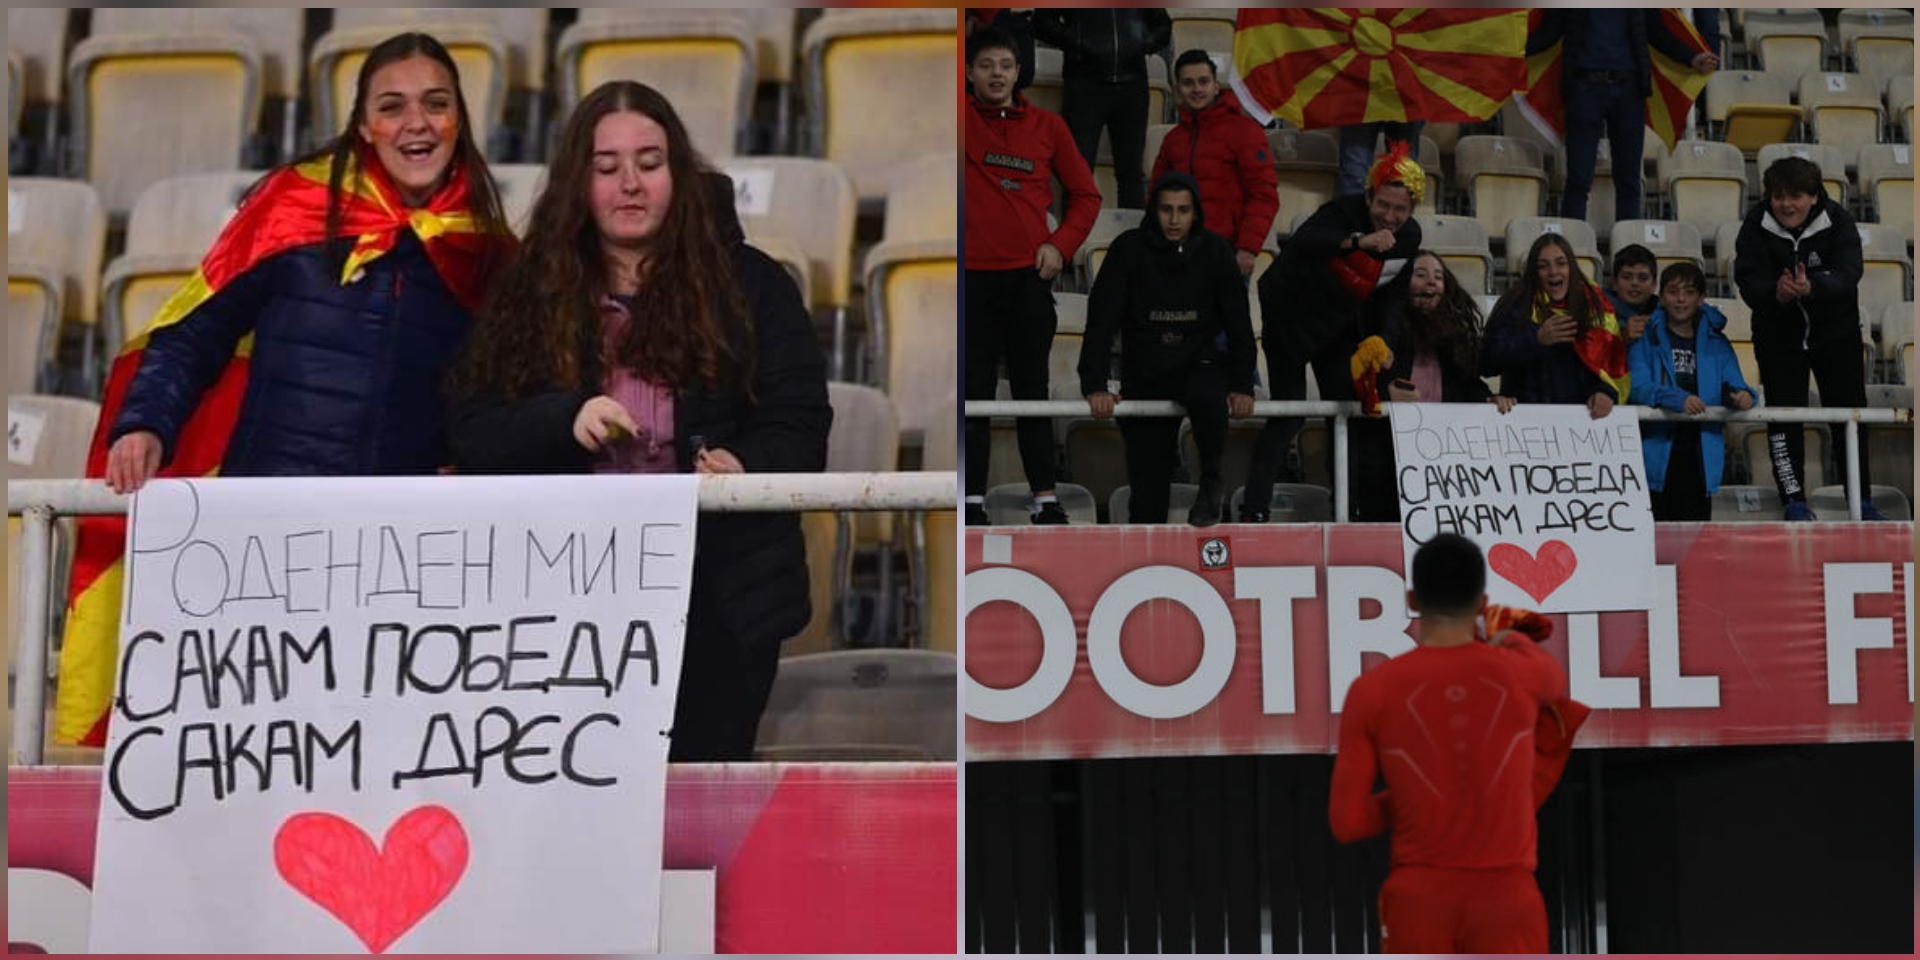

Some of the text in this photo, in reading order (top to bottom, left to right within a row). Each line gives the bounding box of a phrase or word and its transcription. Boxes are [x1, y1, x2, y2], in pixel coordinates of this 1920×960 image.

[1390, 403, 1639, 463] РОДЕНДЕН МИ Е
[1399, 462, 1642, 505] САКАМ ПОБЕДА
[127, 478, 682, 625] РОДЕНДЕН МИ Е
[1404, 502, 1524, 546] САКАМ
[116, 615, 660, 722] САКАМ ПОБЕДА
[965, 563, 1721, 723] OOTBLL
[108, 718, 361, 821] САКАМ
